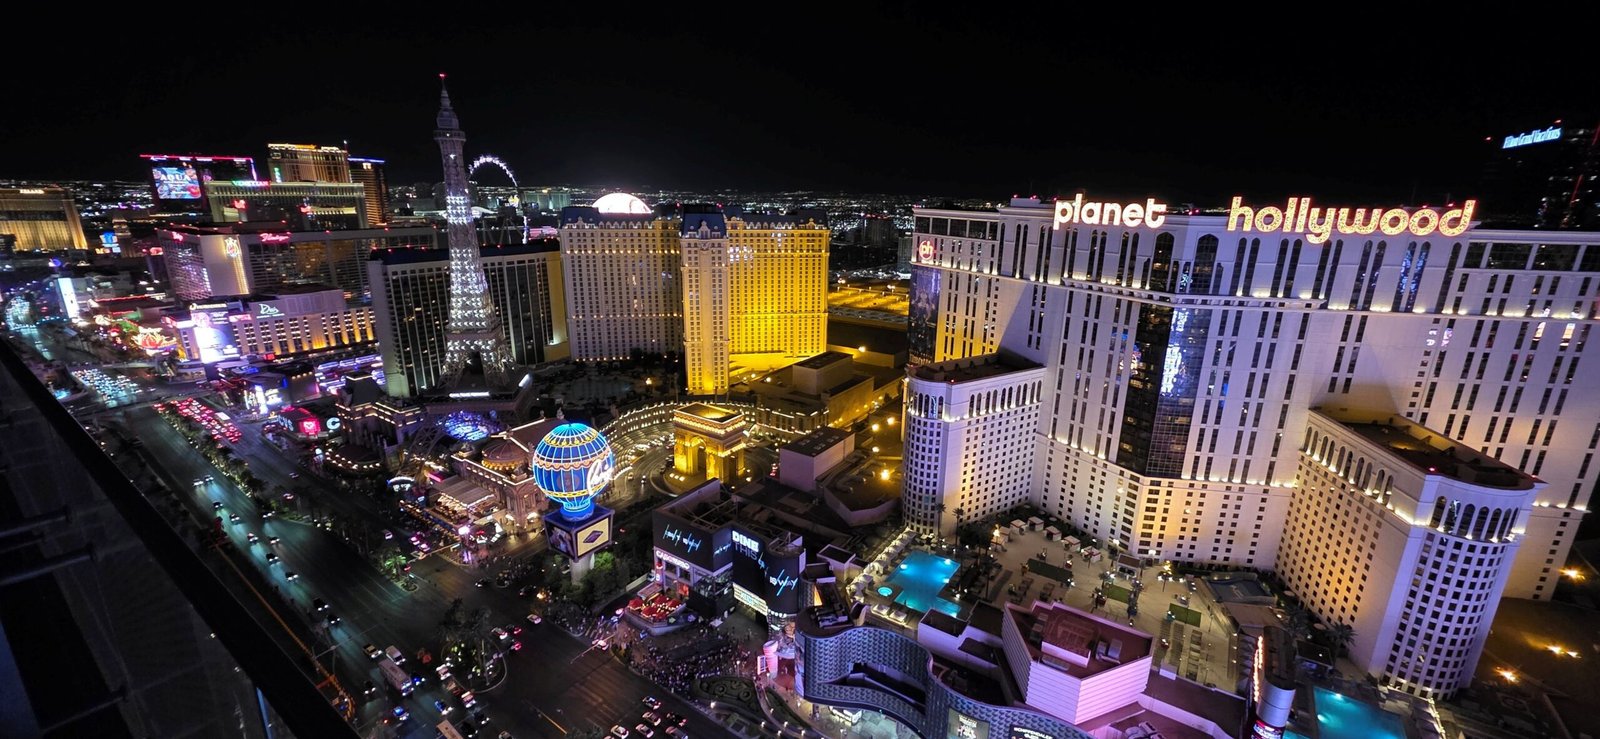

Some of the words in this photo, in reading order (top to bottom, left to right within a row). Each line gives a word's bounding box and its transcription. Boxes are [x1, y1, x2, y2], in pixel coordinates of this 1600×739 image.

[160, 174, 191, 182] AQUA
[1053, 193, 1167, 230] planet
[1227, 196, 1476, 244] hollywood
[731, 530, 760, 552] DINE
[733, 541, 759, 561] THIS
